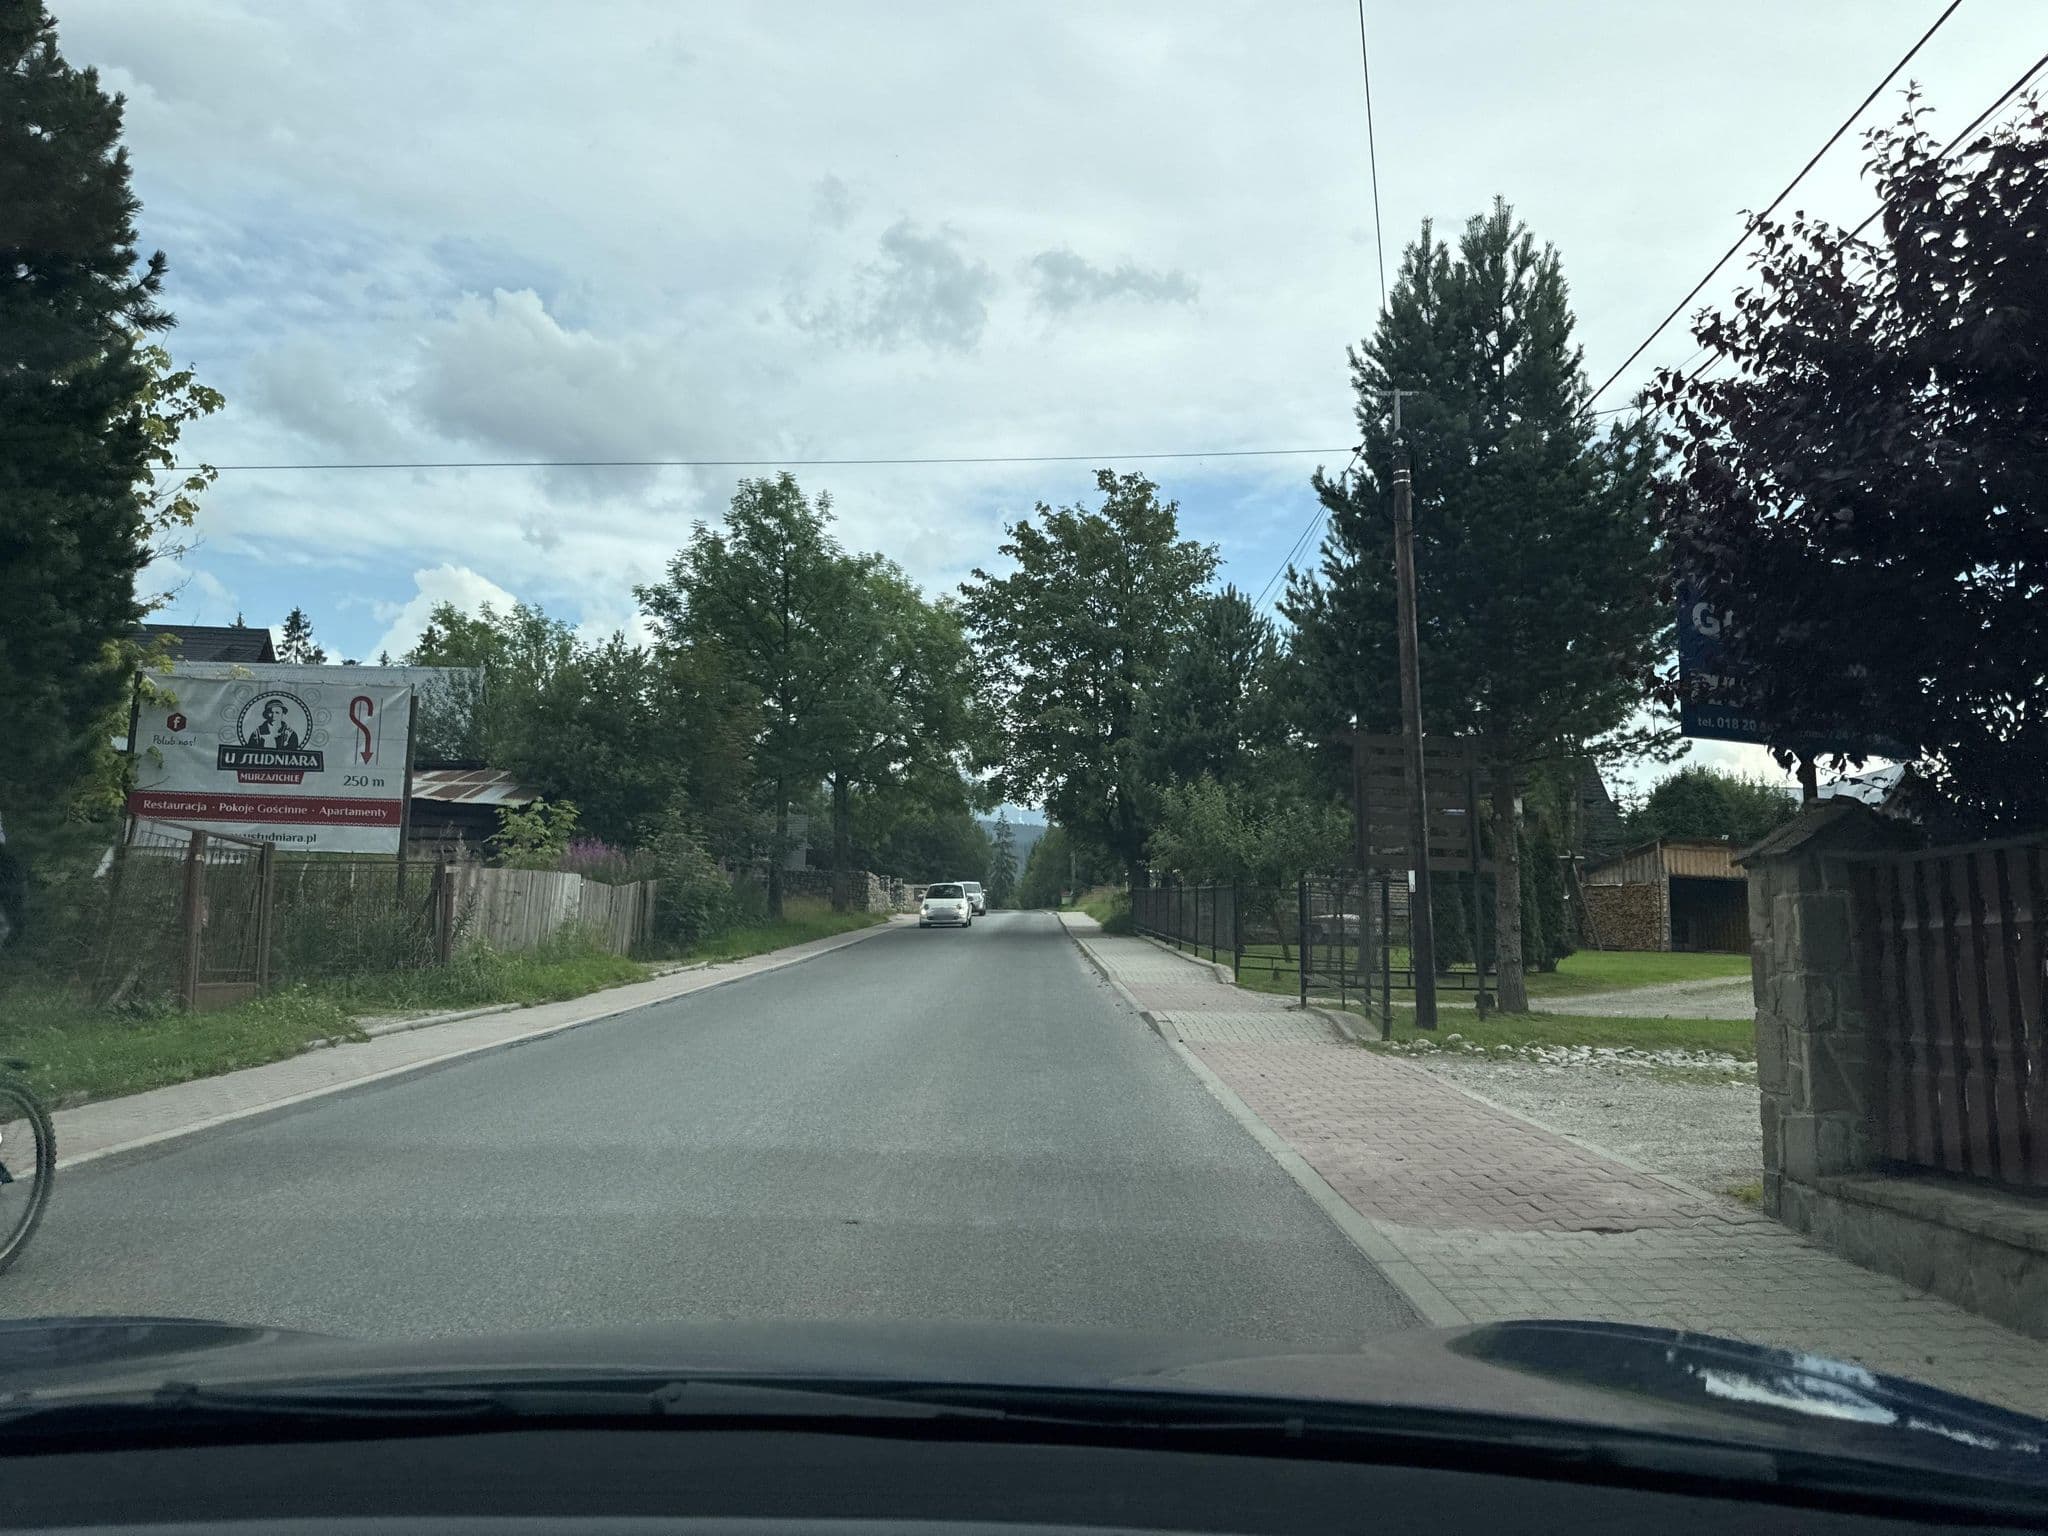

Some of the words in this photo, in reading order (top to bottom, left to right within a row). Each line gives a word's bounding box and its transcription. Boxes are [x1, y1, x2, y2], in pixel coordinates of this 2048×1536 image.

[1697, 717, 1715, 727] tel.
[1717, 716, 1739, 729] 018
[240, 753, 318, 767] STUDNIARA
[240, 773, 300, 783] MURZASICHLE
[343, 775, 369, 787] 250
[372, 778, 385, 787] m
[143, 799, 207, 813] Restauracja
[219, 802, 255, 814] Pokoje
[257, 804, 308, 815] Gościnne
[319, 806, 389, 819] Apartamenty
